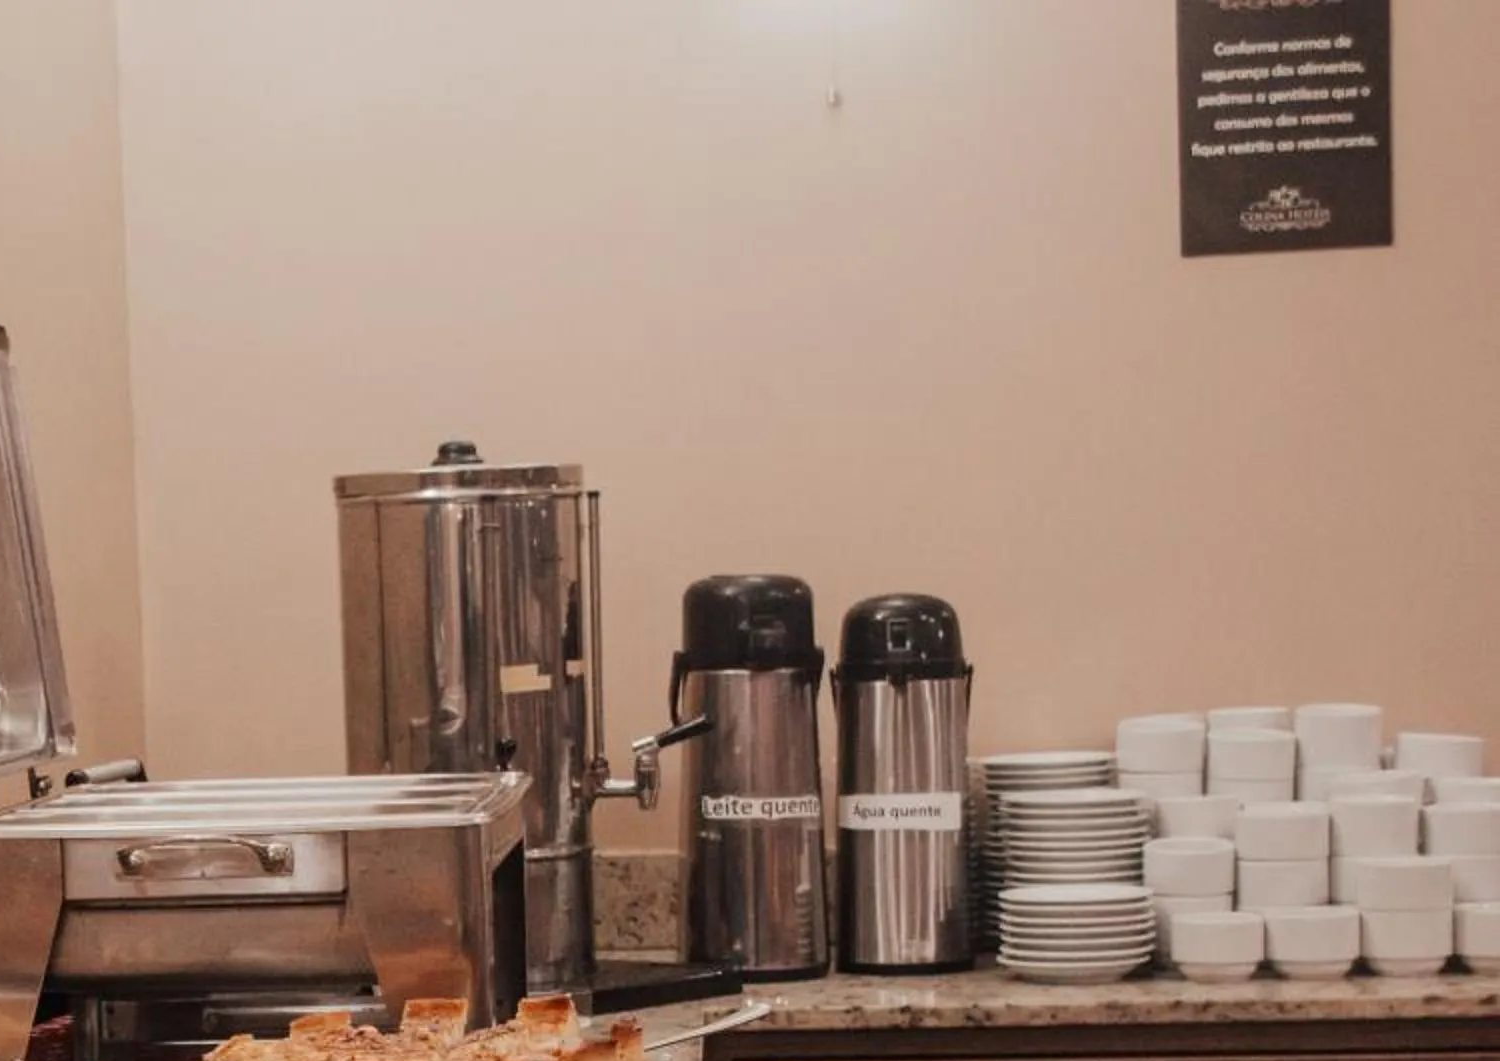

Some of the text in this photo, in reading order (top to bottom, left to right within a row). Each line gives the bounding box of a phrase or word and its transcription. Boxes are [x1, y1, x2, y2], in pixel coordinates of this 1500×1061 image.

[1213, 34, 1353, 57] Conforme normas de
[1255, 92, 1266, 104] a
[1268, 86, 1329, 104] gentileza
[1331, 86, 1358, 102] que
[1360, 85, 1371, 98] o
[1214, 116, 1273, 131] consumo
[1191, 142, 1225, 157] fique
[1228, 139, 1274, 154] restrito
[1276, 138, 1295, 152] ao
[702, 797, 753, 817] Leite
[889, 804, 942, 821] quente
